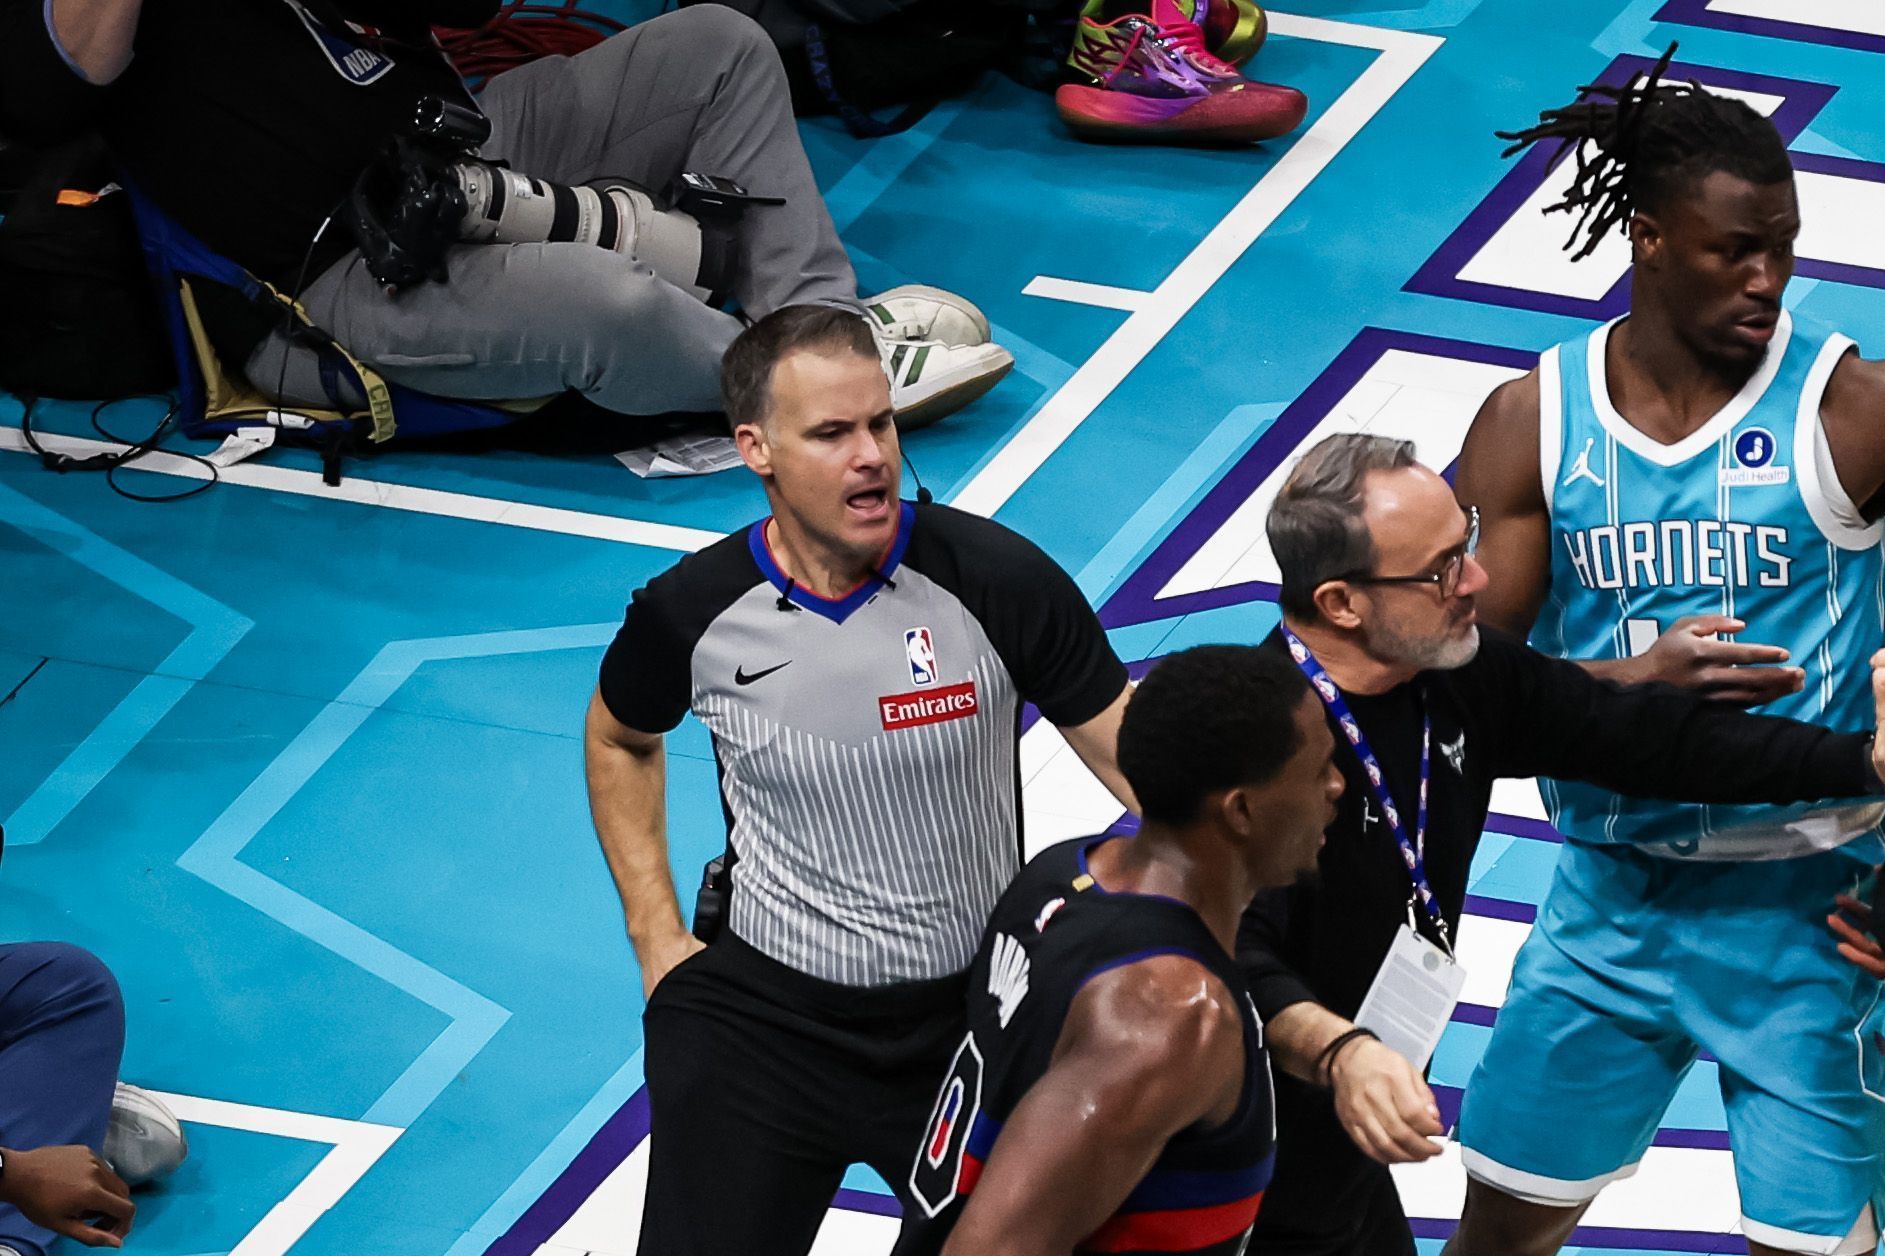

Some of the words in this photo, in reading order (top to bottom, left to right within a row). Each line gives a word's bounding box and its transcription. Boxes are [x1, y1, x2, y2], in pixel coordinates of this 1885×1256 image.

[343, 48, 382, 78] NBA
[1722, 472, 1749, 483] Judi
[1752, 470, 1788, 482] Health
[1564, 520, 1792, 589] HORNETS
[883, 692, 975, 723] Emirates
